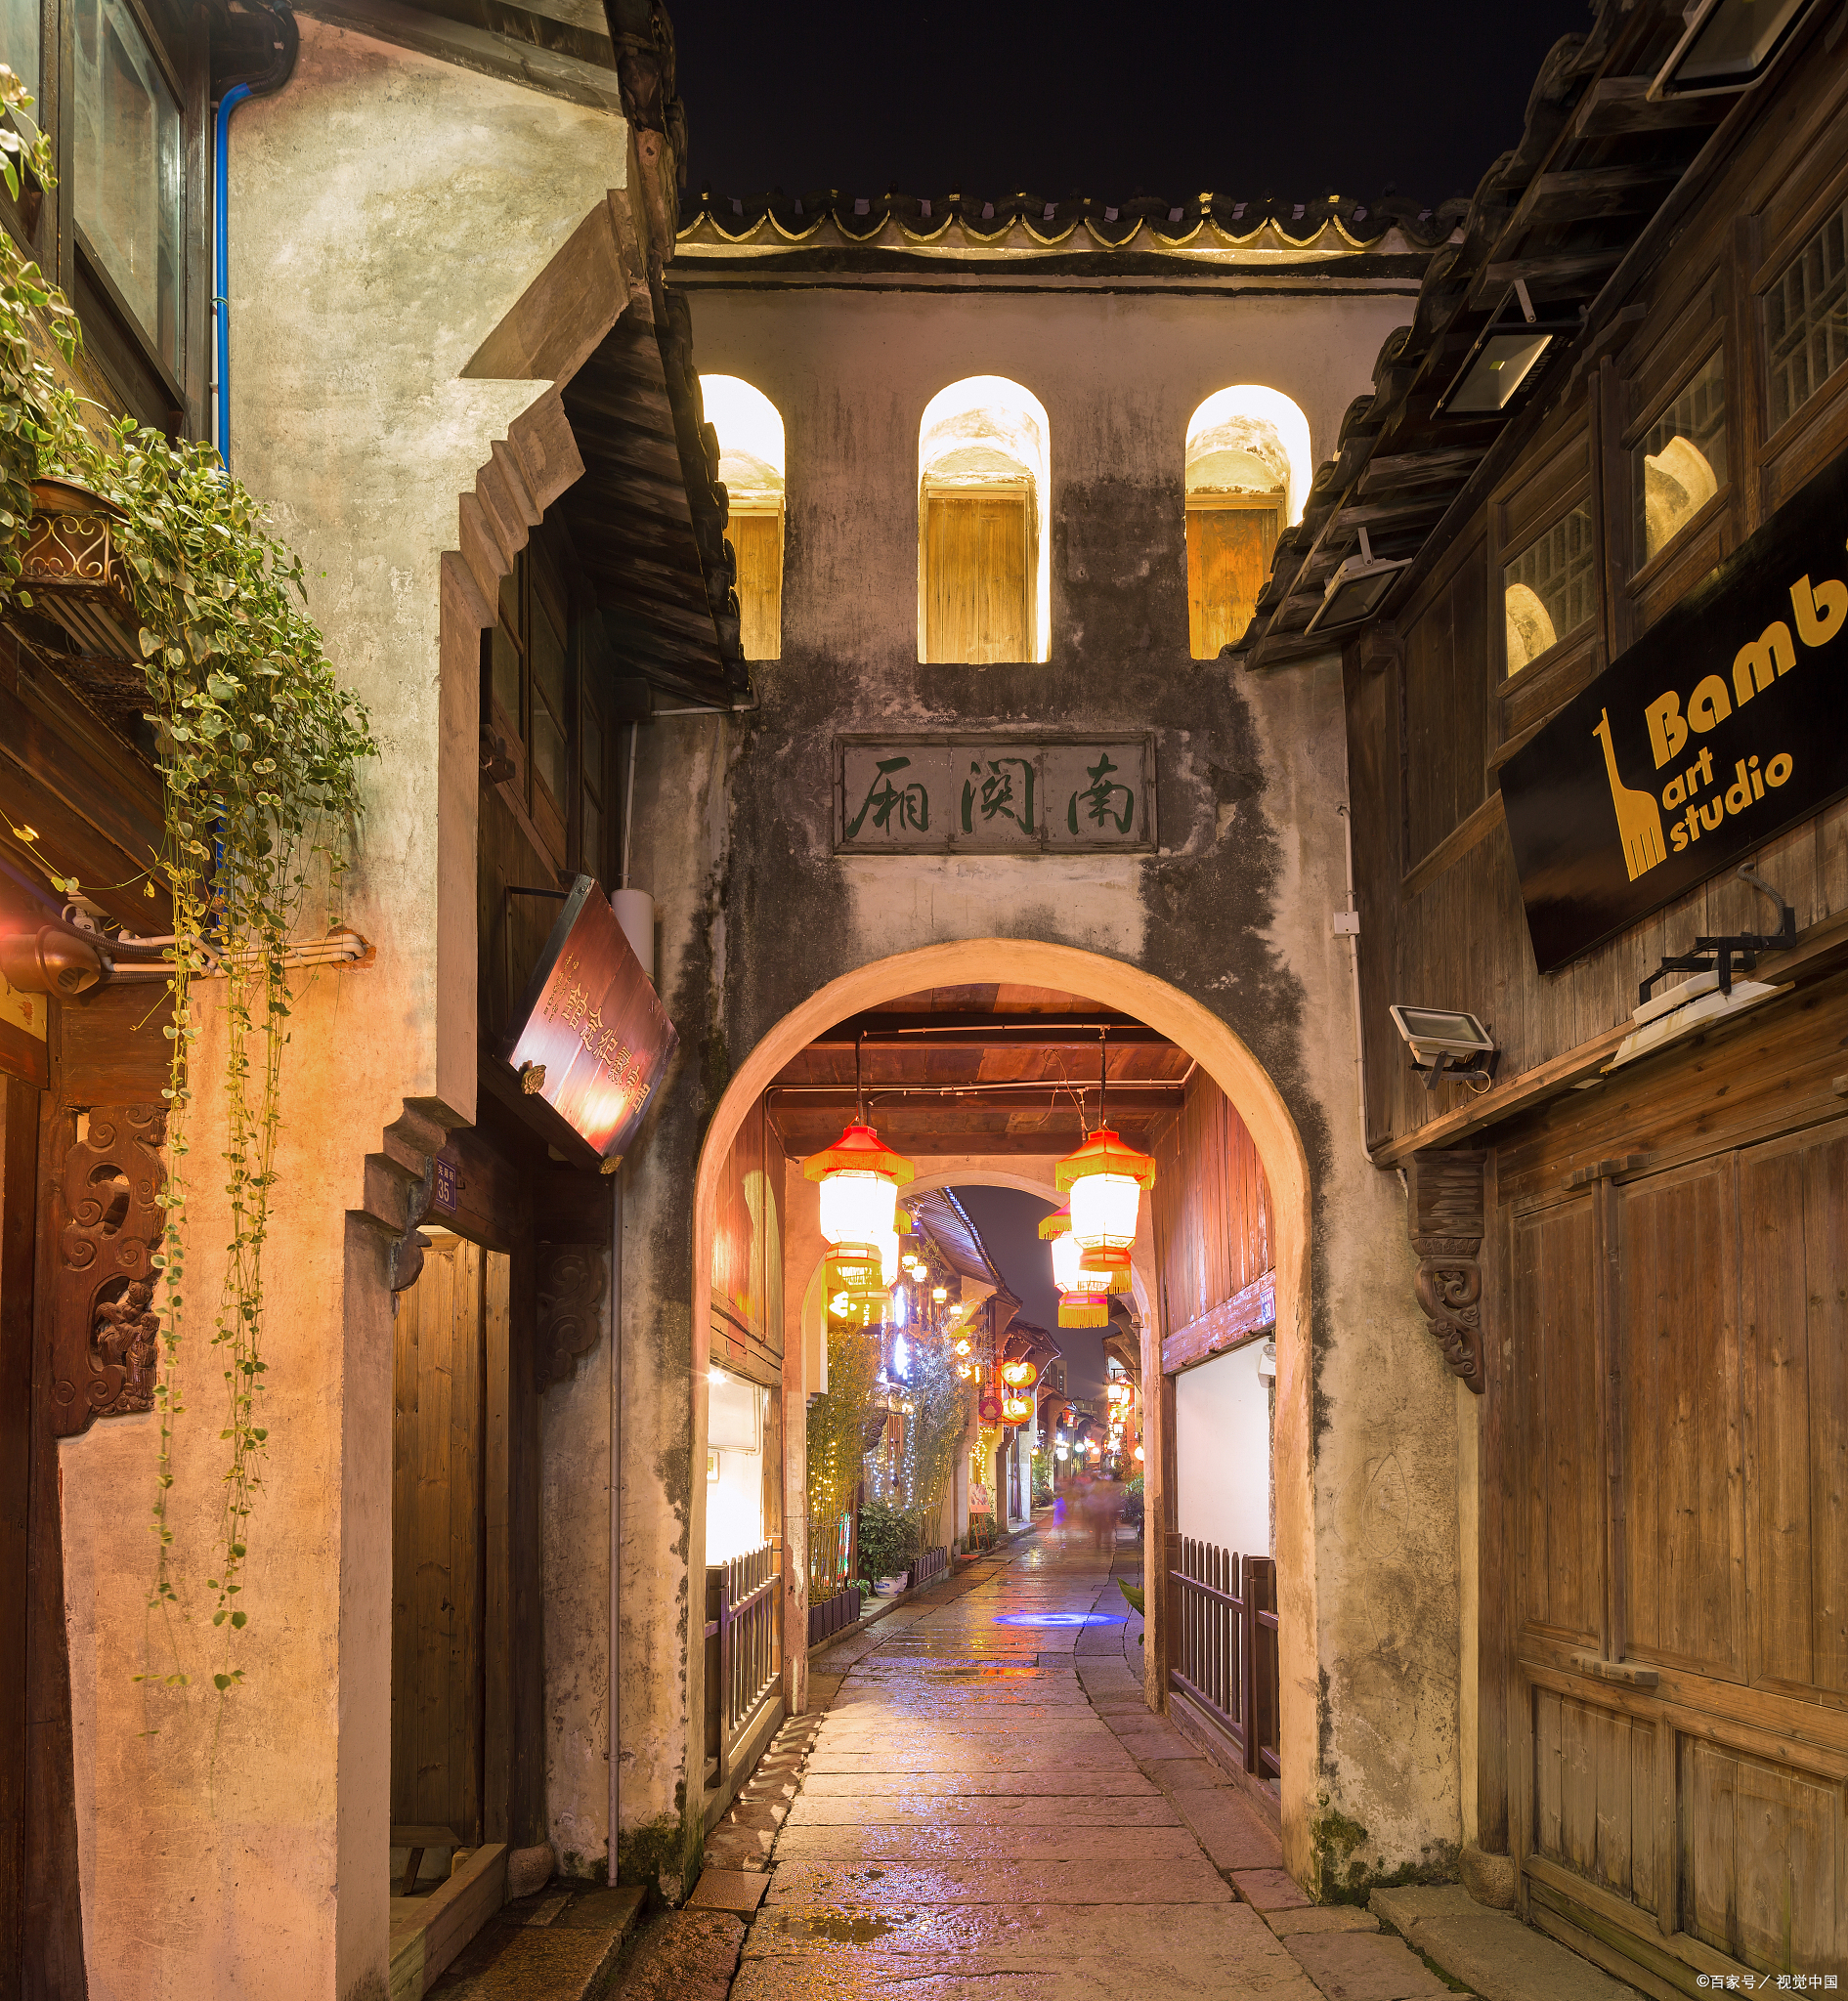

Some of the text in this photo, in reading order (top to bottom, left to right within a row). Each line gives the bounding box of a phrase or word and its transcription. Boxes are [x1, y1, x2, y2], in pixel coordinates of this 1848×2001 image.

[1519, 355, 1552, 393] SHILIN
[1645, 537, 1848, 770] Bamb
[1662, 746, 1713, 811] art
[1670, 752, 1793, 852] studio
[438, 1178, 450, 1202] 35
